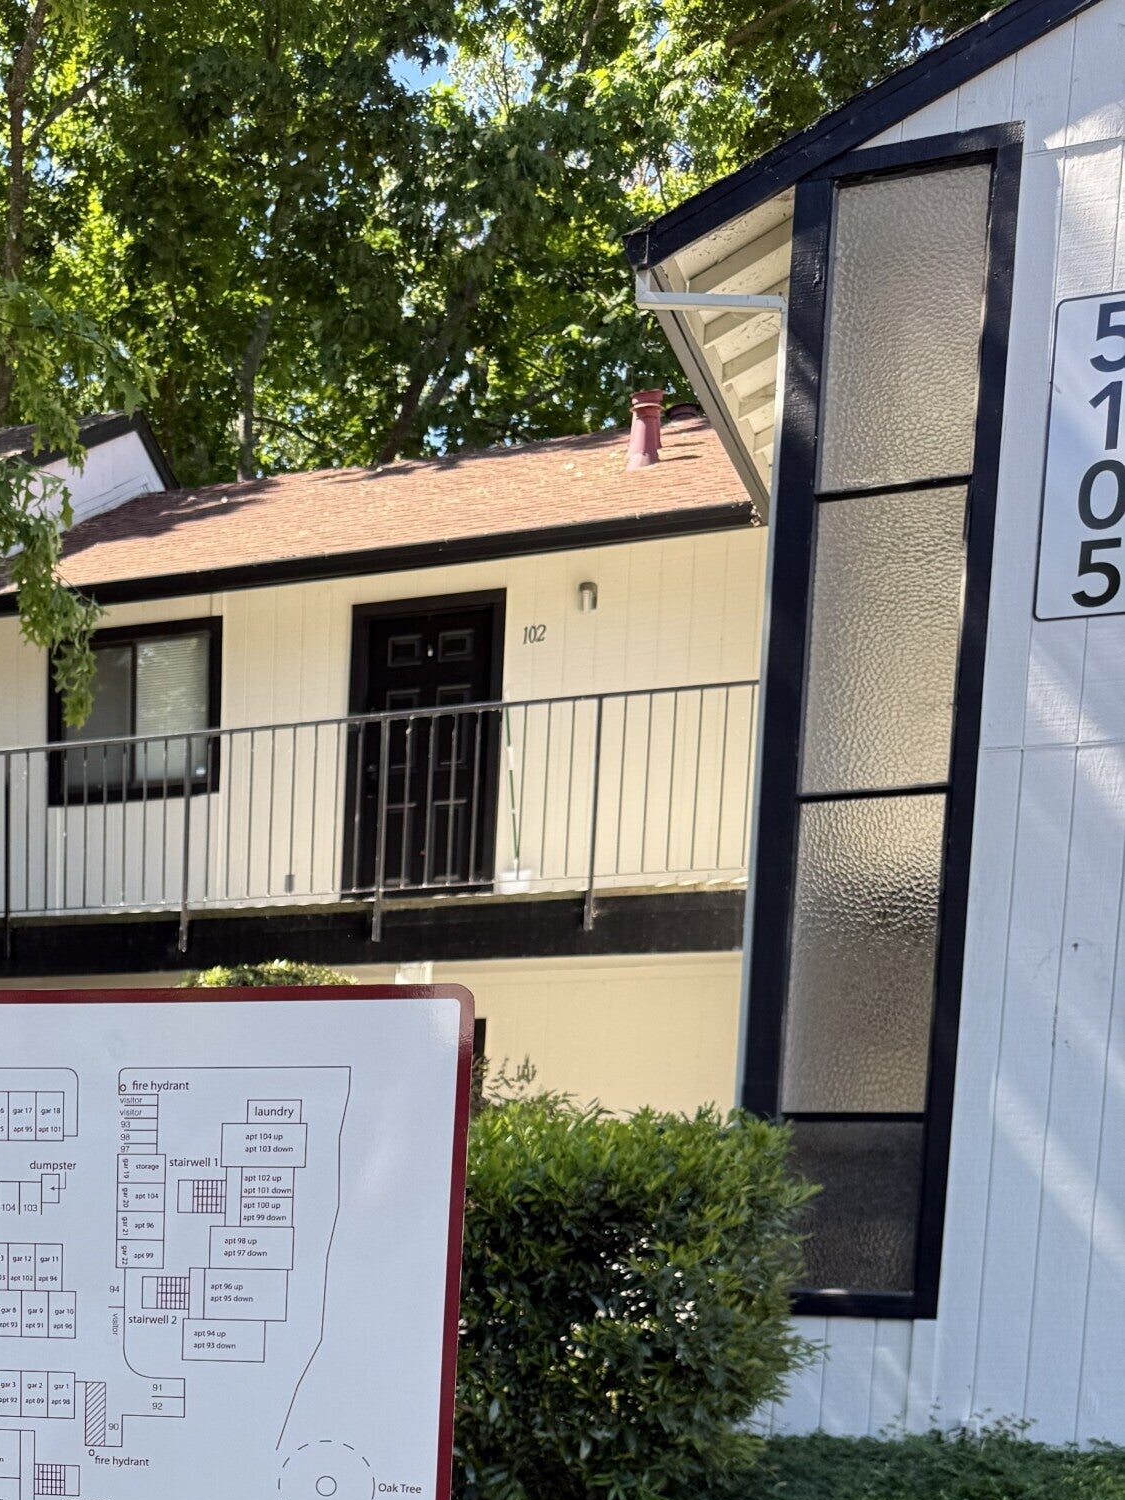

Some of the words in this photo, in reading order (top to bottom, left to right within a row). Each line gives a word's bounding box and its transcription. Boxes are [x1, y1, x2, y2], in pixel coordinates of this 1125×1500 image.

[1072, 299, 1125, 609] 5105
[523, 624, 547, 645] 102
[132, 1081, 149, 1091] fire
[150, 1081, 189, 1092] hydrant
[120, 1096, 143, 1104] visitor
[254, 1106, 294, 1118] laundry
[30, 1161, 76, 1171] dumpster
[169, 1158, 212, 1167] stairwell
[214, 1158, 218, 1167] 1
[2, 1204, 16, 1212] 104
[23, 1204, 37, 1212] 103
[243, 1214, 255, 1222] apt
[211, 1283, 222, 1291] apt
[128, 1315, 169, 1324] stairwell
[171, 1316, 177, 1324] 2
[152, 1402, 163, 1410] 92
[95, 1455, 110, 1465] fire
[112, 1456, 149, 1467] hydrant
[378, 1484, 398, 1494] Oak
[400, 1484, 422, 1494] Tree
